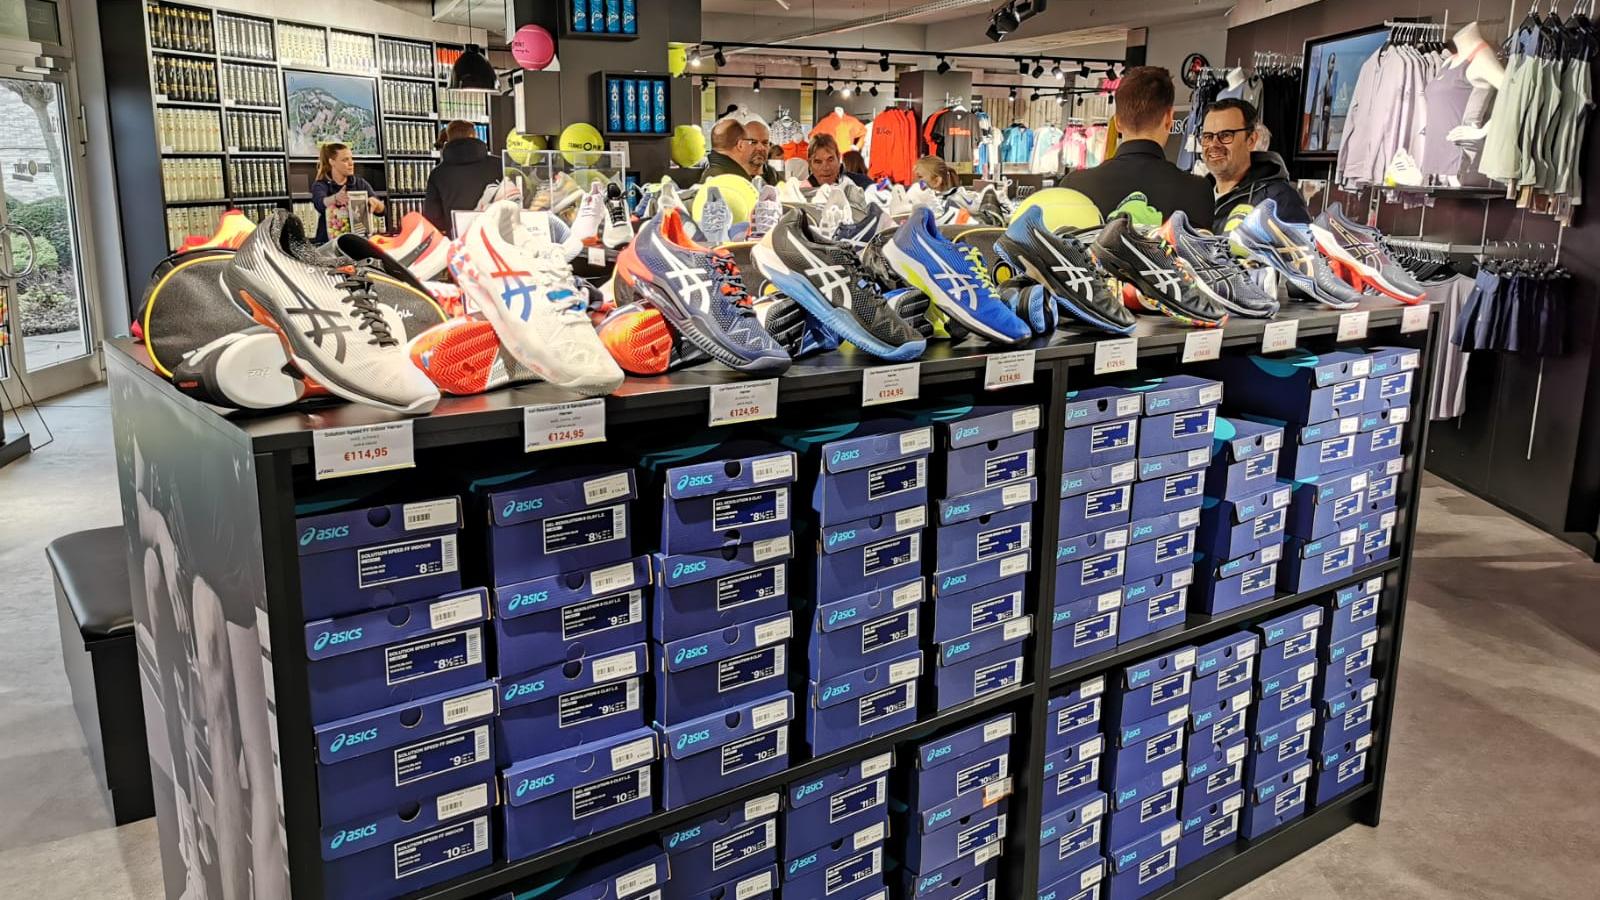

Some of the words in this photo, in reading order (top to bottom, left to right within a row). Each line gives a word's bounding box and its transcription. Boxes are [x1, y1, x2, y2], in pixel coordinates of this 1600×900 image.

[729, 406, 760, 417] €124,95
[548, 428, 584, 442] €124,95
[344, 447, 388, 461] €114,95
[689, 474, 713, 487] asics
[516, 498, 543, 512] asics
[316, 525, 349, 541] asics
[419, 563, 428, 573] 8
[683, 560, 707, 574] asics
[521, 591, 548, 606] asics
[758, 589, 765, 597] 9
[610, 615, 618, 625] 9
[329, 628, 363, 644] asics
[685, 645, 708, 659] asics
[518, 680, 545, 695] asics
[346, 728, 378, 746] asics
[687, 729, 710, 744] asics
[453, 755, 461, 766] 9
[757, 750, 767, 760] 10
[528, 773, 555, 790] asics
[615, 792, 627, 803] 10
[346, 824, 377, 842] asics
[679, 826, 701, 842] asics
[447, 846, 460, 858] 10
